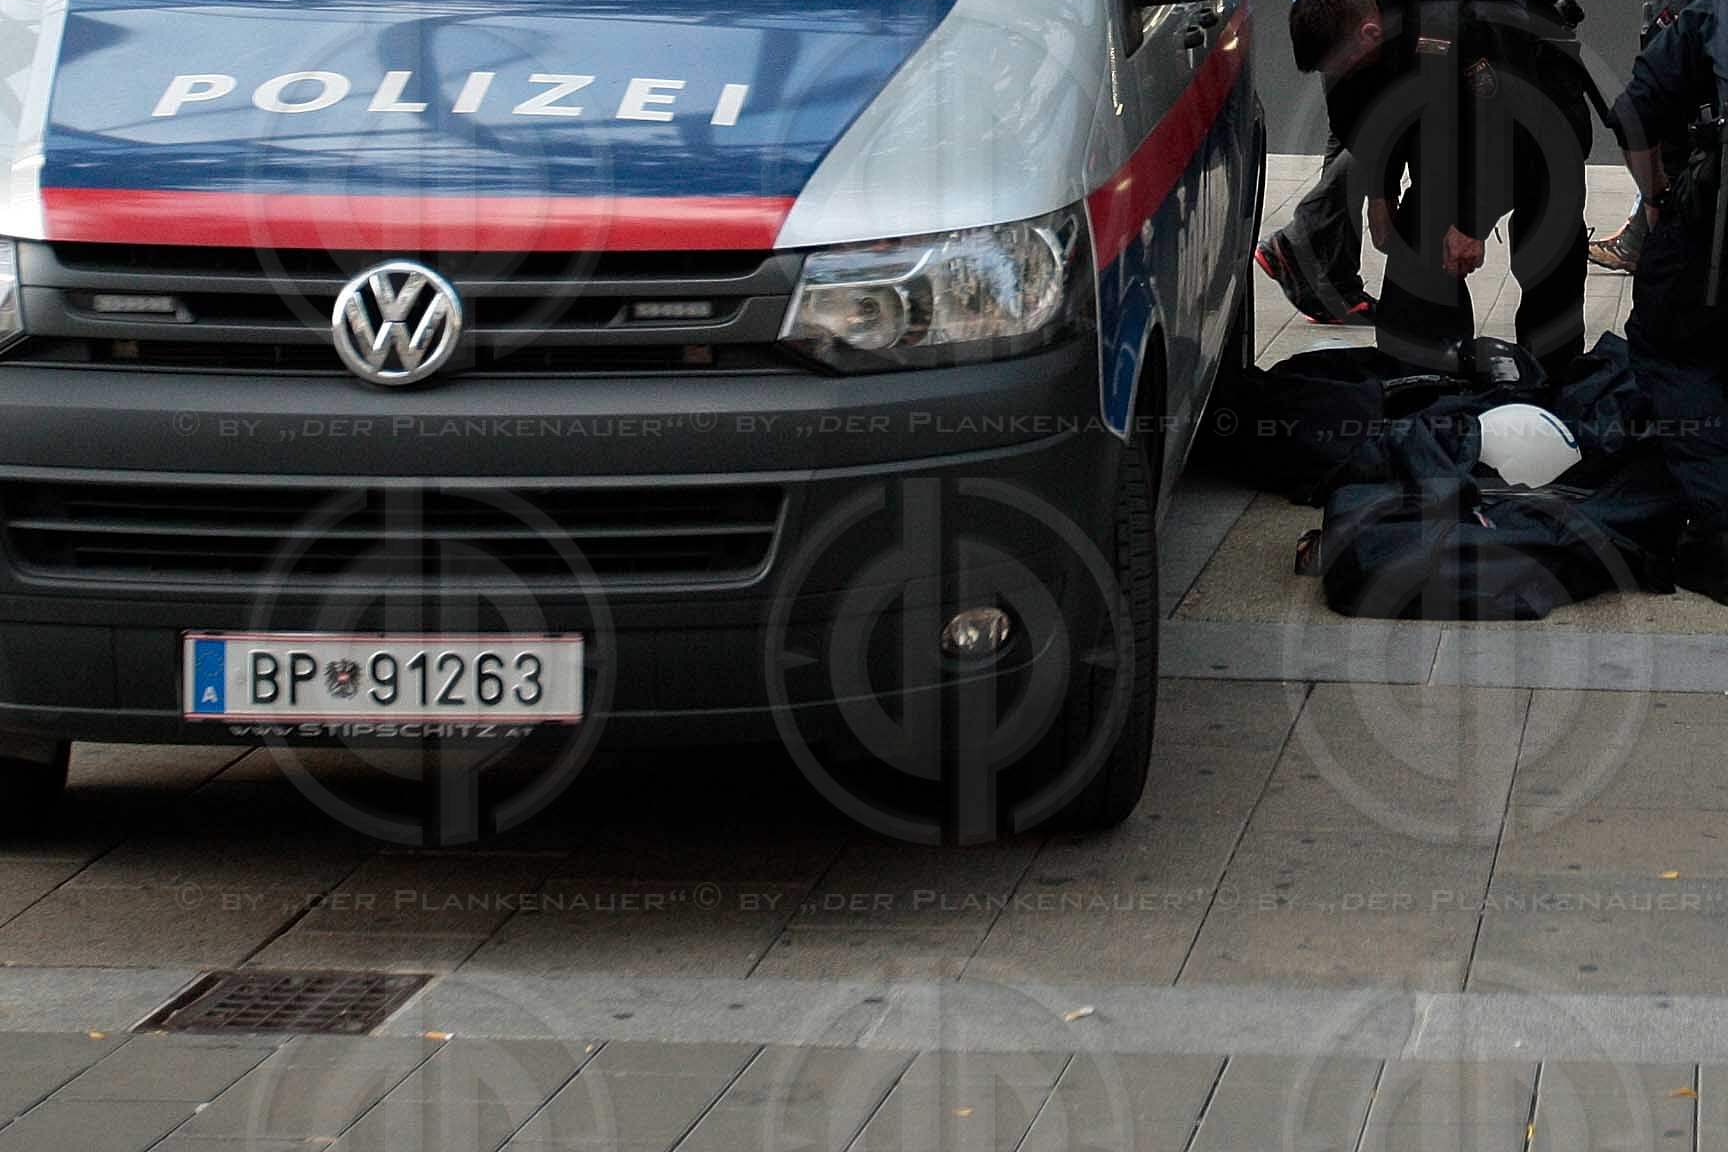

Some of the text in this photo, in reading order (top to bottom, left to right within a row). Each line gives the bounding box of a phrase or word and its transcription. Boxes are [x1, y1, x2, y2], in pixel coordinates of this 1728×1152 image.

[151, 70, 750, 127] POLIZEI
[248, 650, 542, 707] BP 91263
